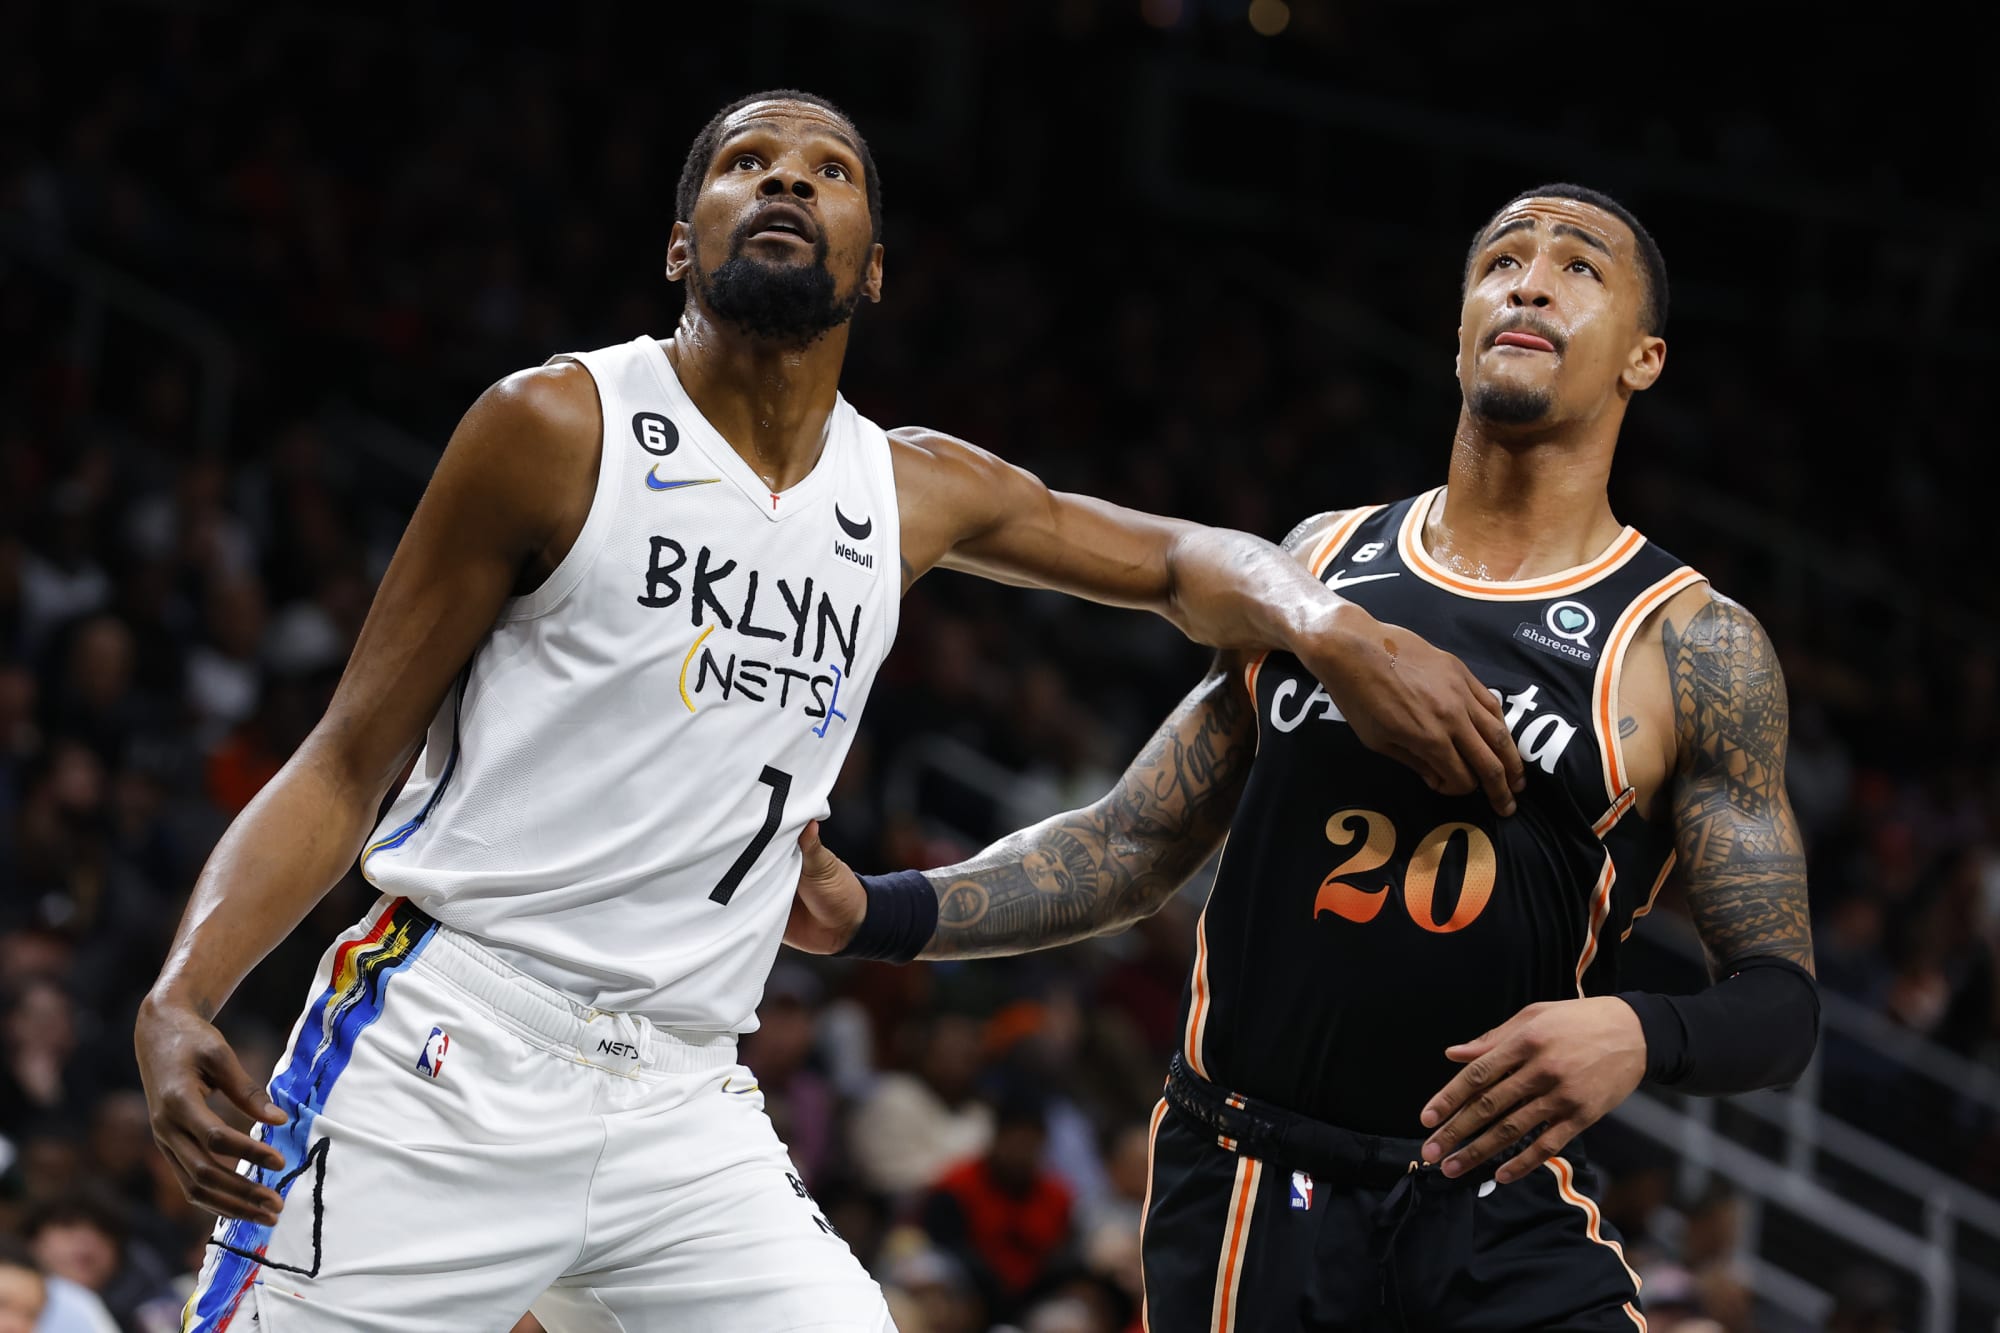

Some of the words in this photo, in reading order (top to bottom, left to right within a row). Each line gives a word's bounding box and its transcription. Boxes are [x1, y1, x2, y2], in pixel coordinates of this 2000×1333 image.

[641, 417, 667, 451] 6
[834, 540, 873, 569] Webull
[1351, 542, 1385, 562] 6
[637, 535, 862, 679] BKLYN
[1522, 628, 1591, 661] sharecare
[708, 764, 793, 906] 7
[1314, 808, 1497, 934] 20
